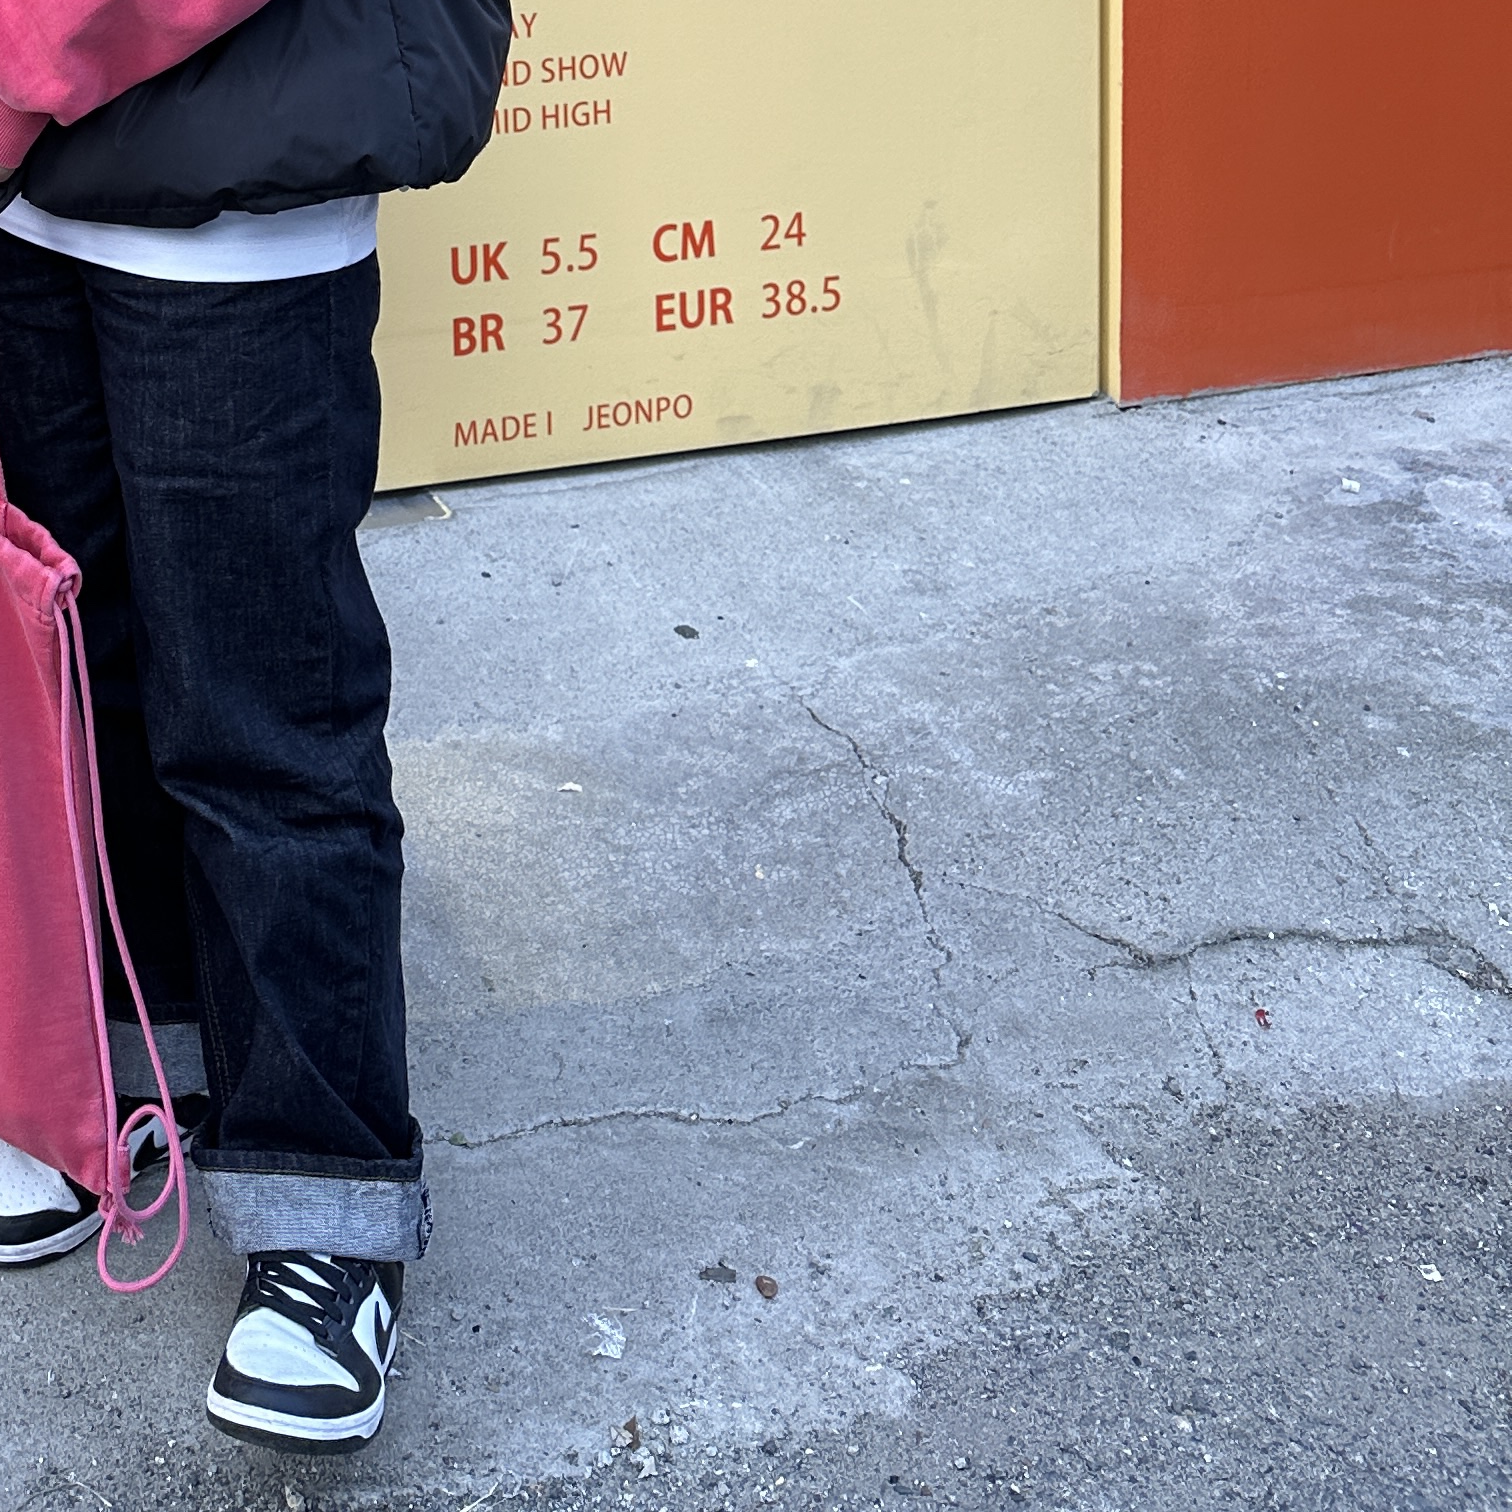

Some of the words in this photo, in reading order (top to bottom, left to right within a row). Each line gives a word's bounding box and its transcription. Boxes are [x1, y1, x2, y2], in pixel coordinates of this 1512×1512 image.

[541, 51, 628, 84] SHOW
[541, 99, 611, 131] HIGH
[450, 240, 509, 286] UK
[540, 232, 599, 275] 5.5
[652, 219, 716, 263] CM
[760, 211, 807, 252] 24
[452, 312, 506, 357] BR
[542, 303, 589, 346] 37
[654, 286, 734, 333] EUR
[761, 274, 842, 320] 38.5
[453, 412, 537, 448] MADE
[582, 393, 693, 432] JEONPO
